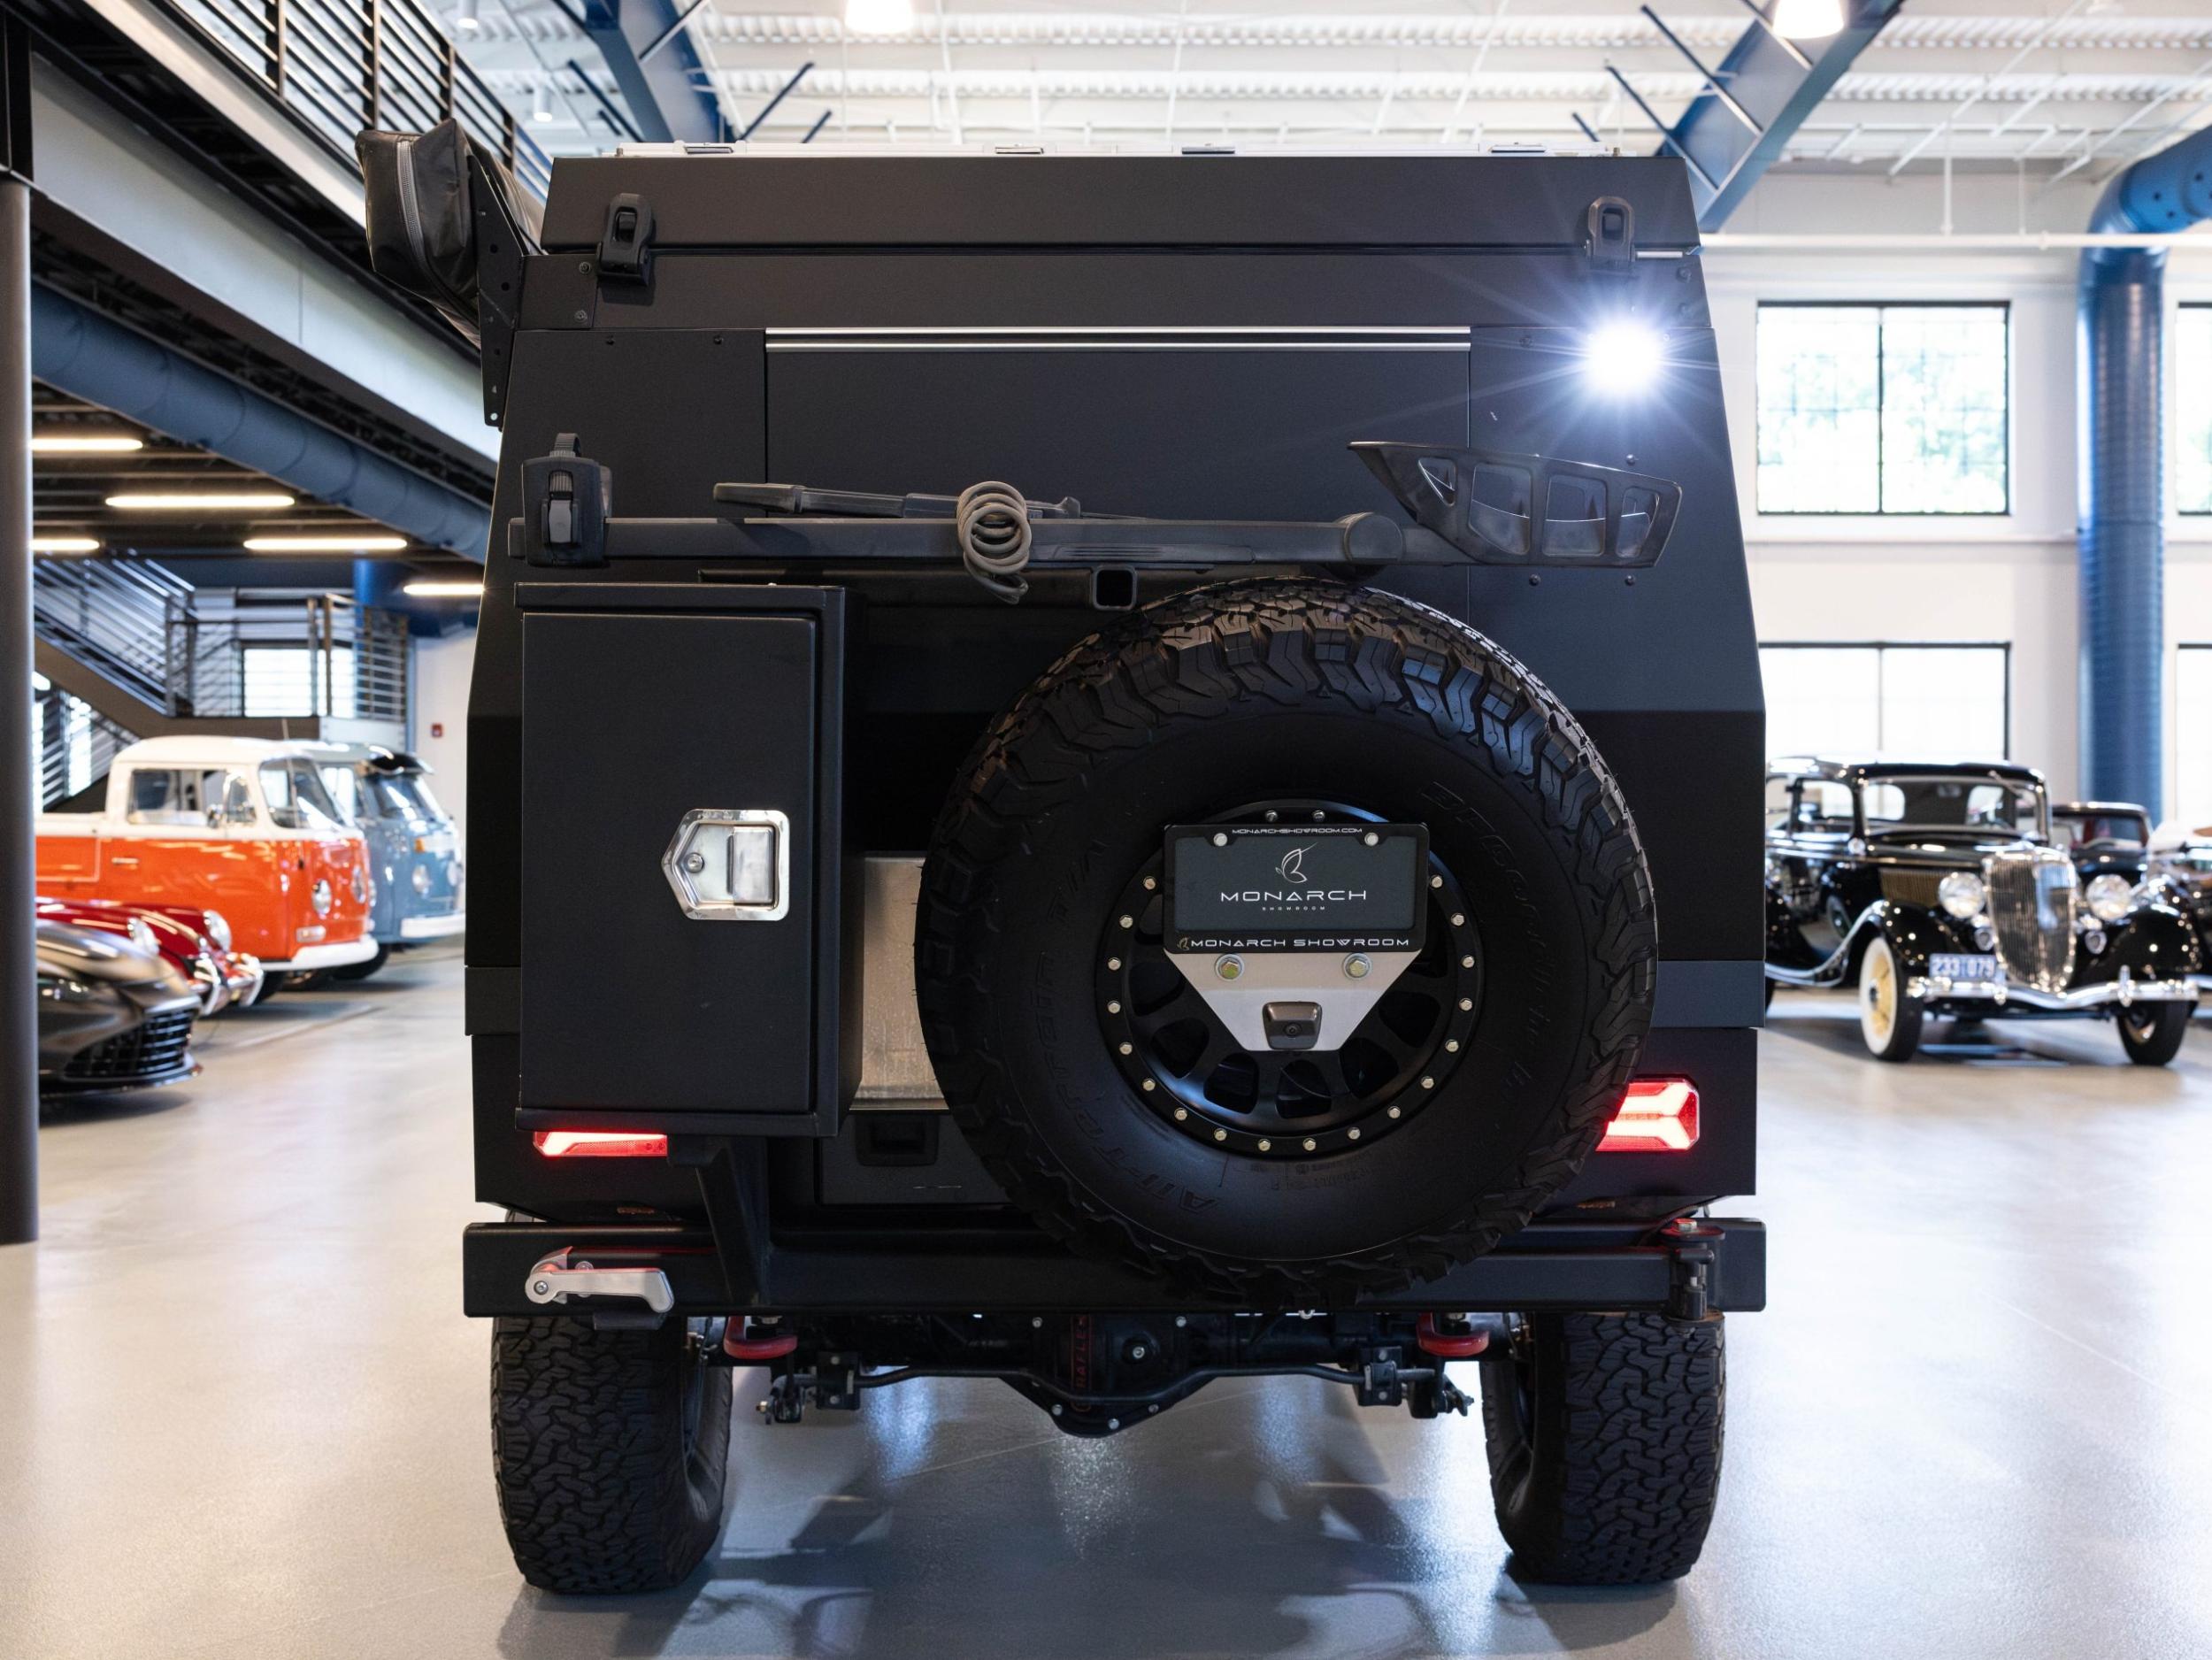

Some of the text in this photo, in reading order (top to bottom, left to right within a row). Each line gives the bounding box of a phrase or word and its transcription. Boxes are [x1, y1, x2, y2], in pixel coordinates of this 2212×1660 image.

[1221, 889, 1367, 902] MONARCH
[1191, 938, 1409, 947] MONARCH SHOWROOM
